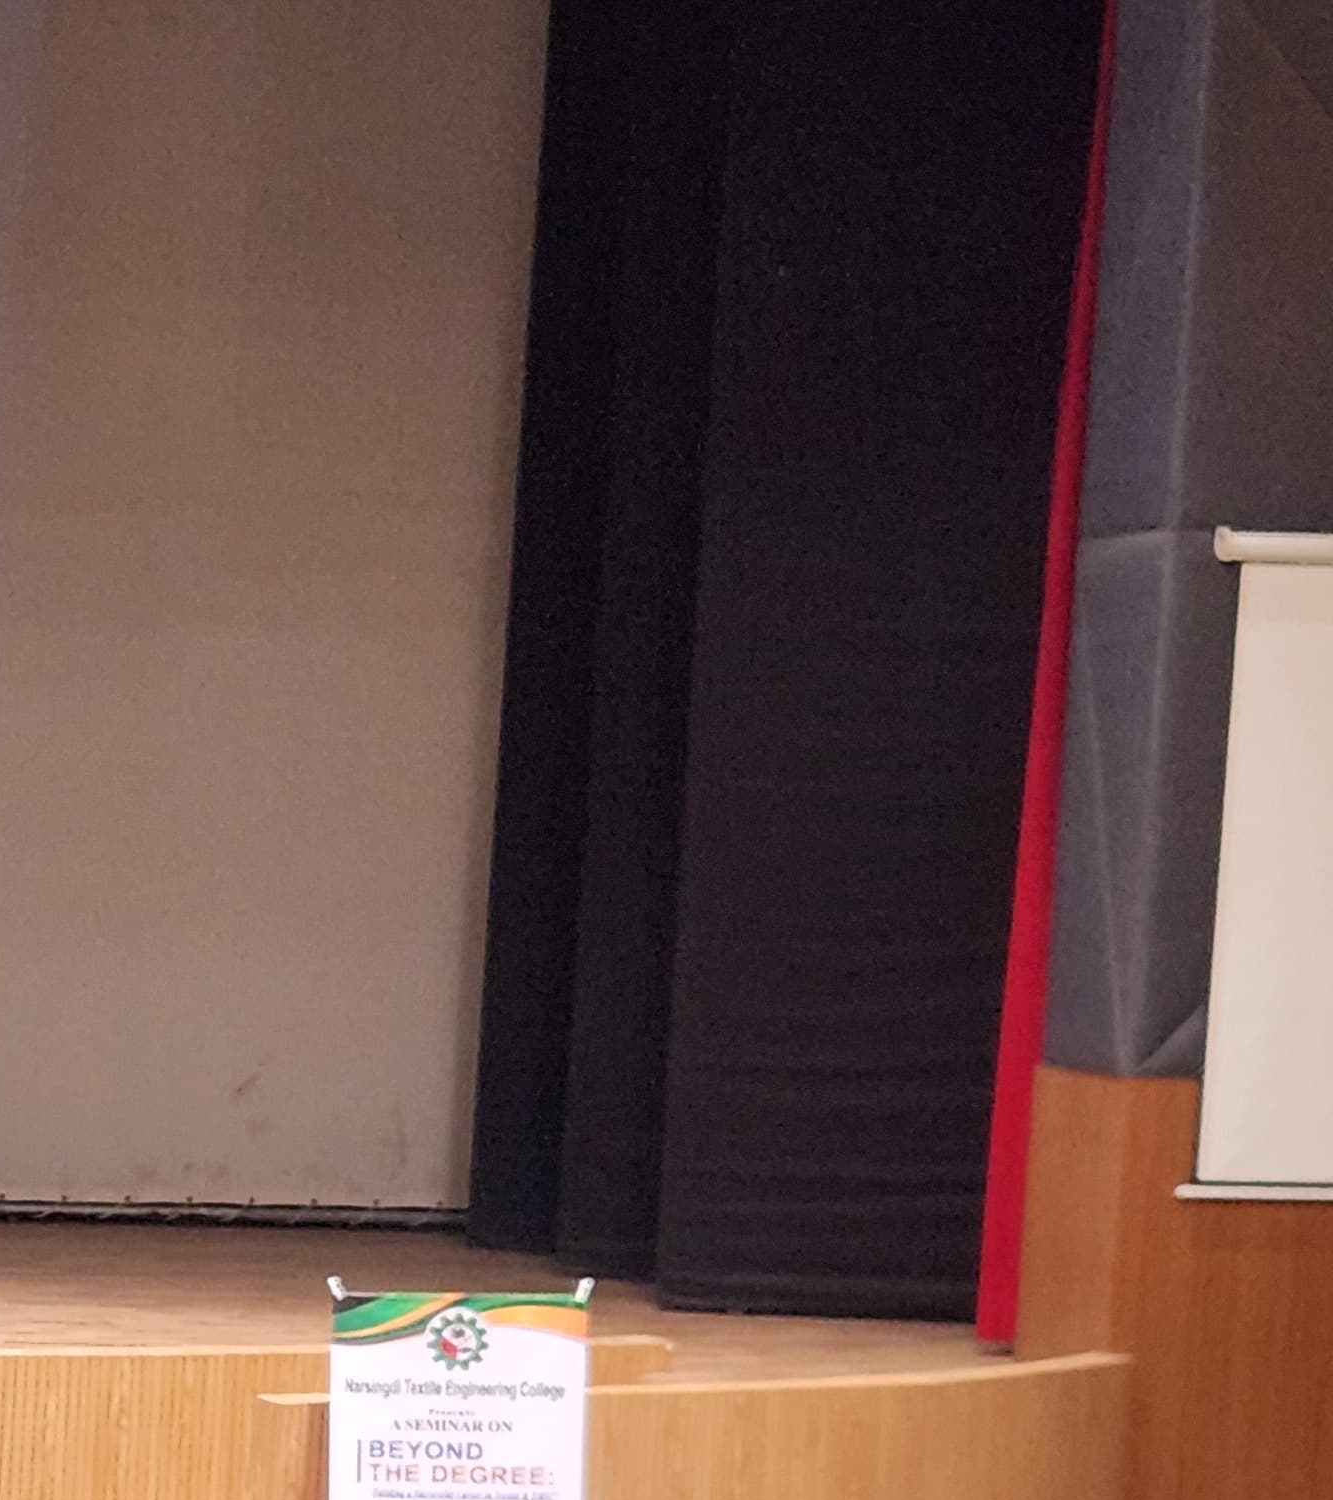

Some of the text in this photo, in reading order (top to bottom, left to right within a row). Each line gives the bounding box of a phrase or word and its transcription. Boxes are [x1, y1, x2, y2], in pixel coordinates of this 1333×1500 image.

[404, 1378, 442, 1396] Textile
[445, 1379, 518, 1400] Engineering
[520, 1381, 566, 1401] College
[404, 1418, 483, 1433] SEMINAR
[487, 1420, 514, 1433] ON
[368, 1439, 484, 1460] BEYOND
[367, 1463, 555, 1486] THE DEGREE:
